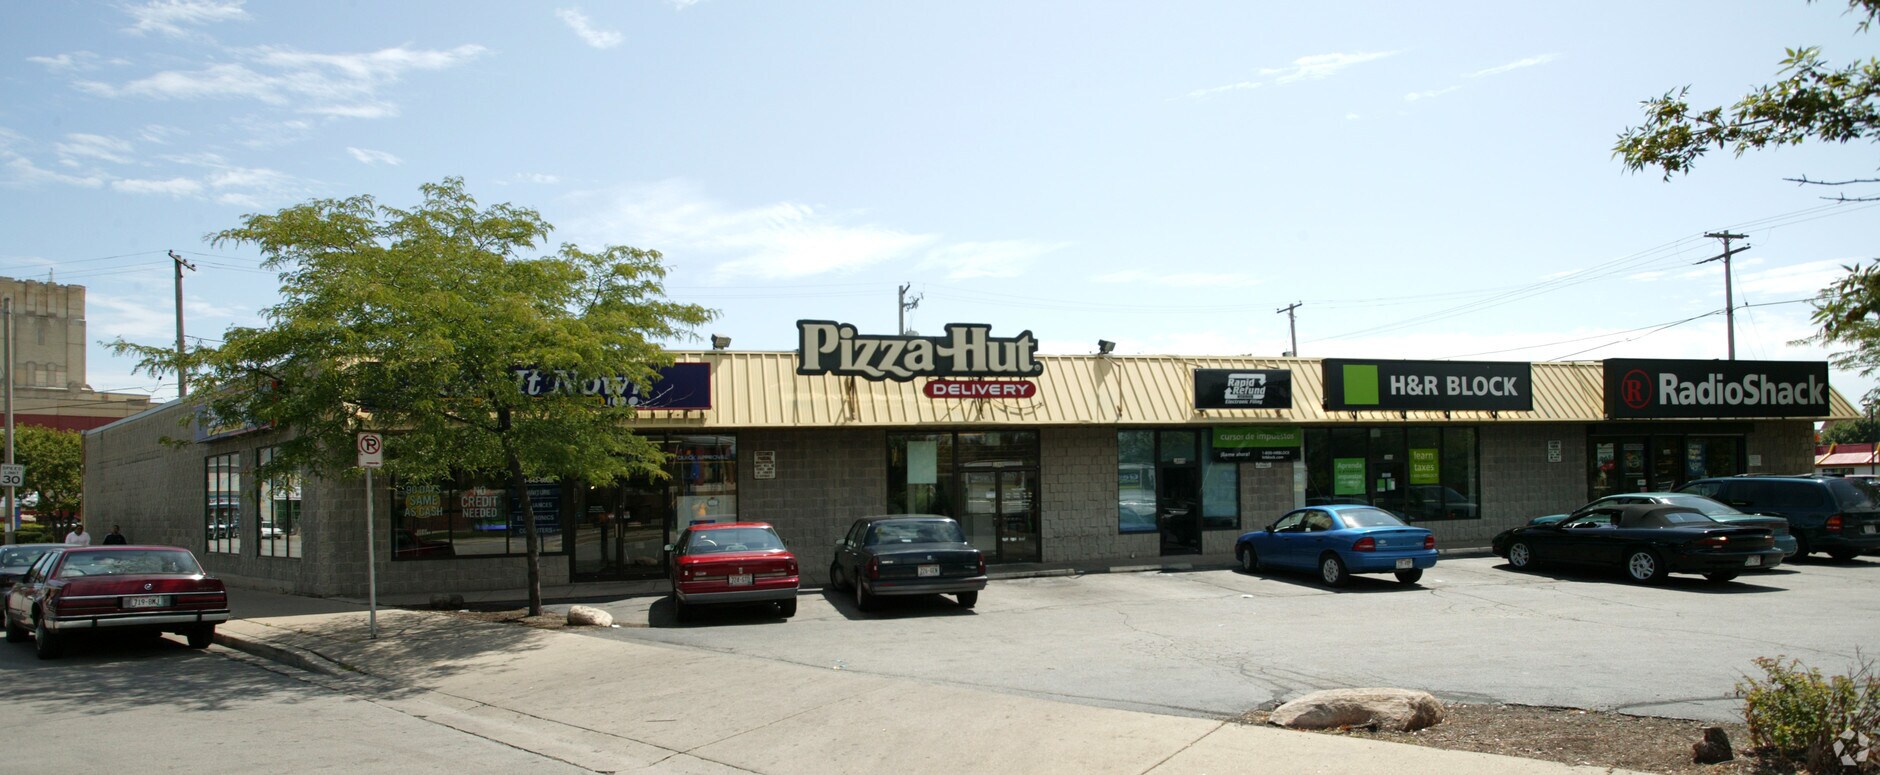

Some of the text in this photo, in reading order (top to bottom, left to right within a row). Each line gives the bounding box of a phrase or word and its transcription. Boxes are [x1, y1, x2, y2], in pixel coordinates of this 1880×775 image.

[801, 323, 1034, 378] Pizza Hut
[516, 369, 542, 396] It
[1227, 378, 1255, 387] Rapid
[1390, 375, 1518, 397] H&R BLOCK
[932, 383, 1030, 396] DELIVERY
[1232, 386, 1266, 395] Refund
[1657, 373, 1824, 405] RadioShack
[1245, 432, 1254, 440] de
[1413, 451, 1434, 460] learn
[1414, 463, 1435, 471] taxes
[2, 475, 20, 485] 30
[406, 485, 417, 494] 90
[473, 485, 487, 496] NO
[410, 495, 437, 506] SAME
[461, 495, 498, 508] CREDIT
[404, 506, 443, 517] AS CASH
[462, 507, 498, 518] NEEDED
